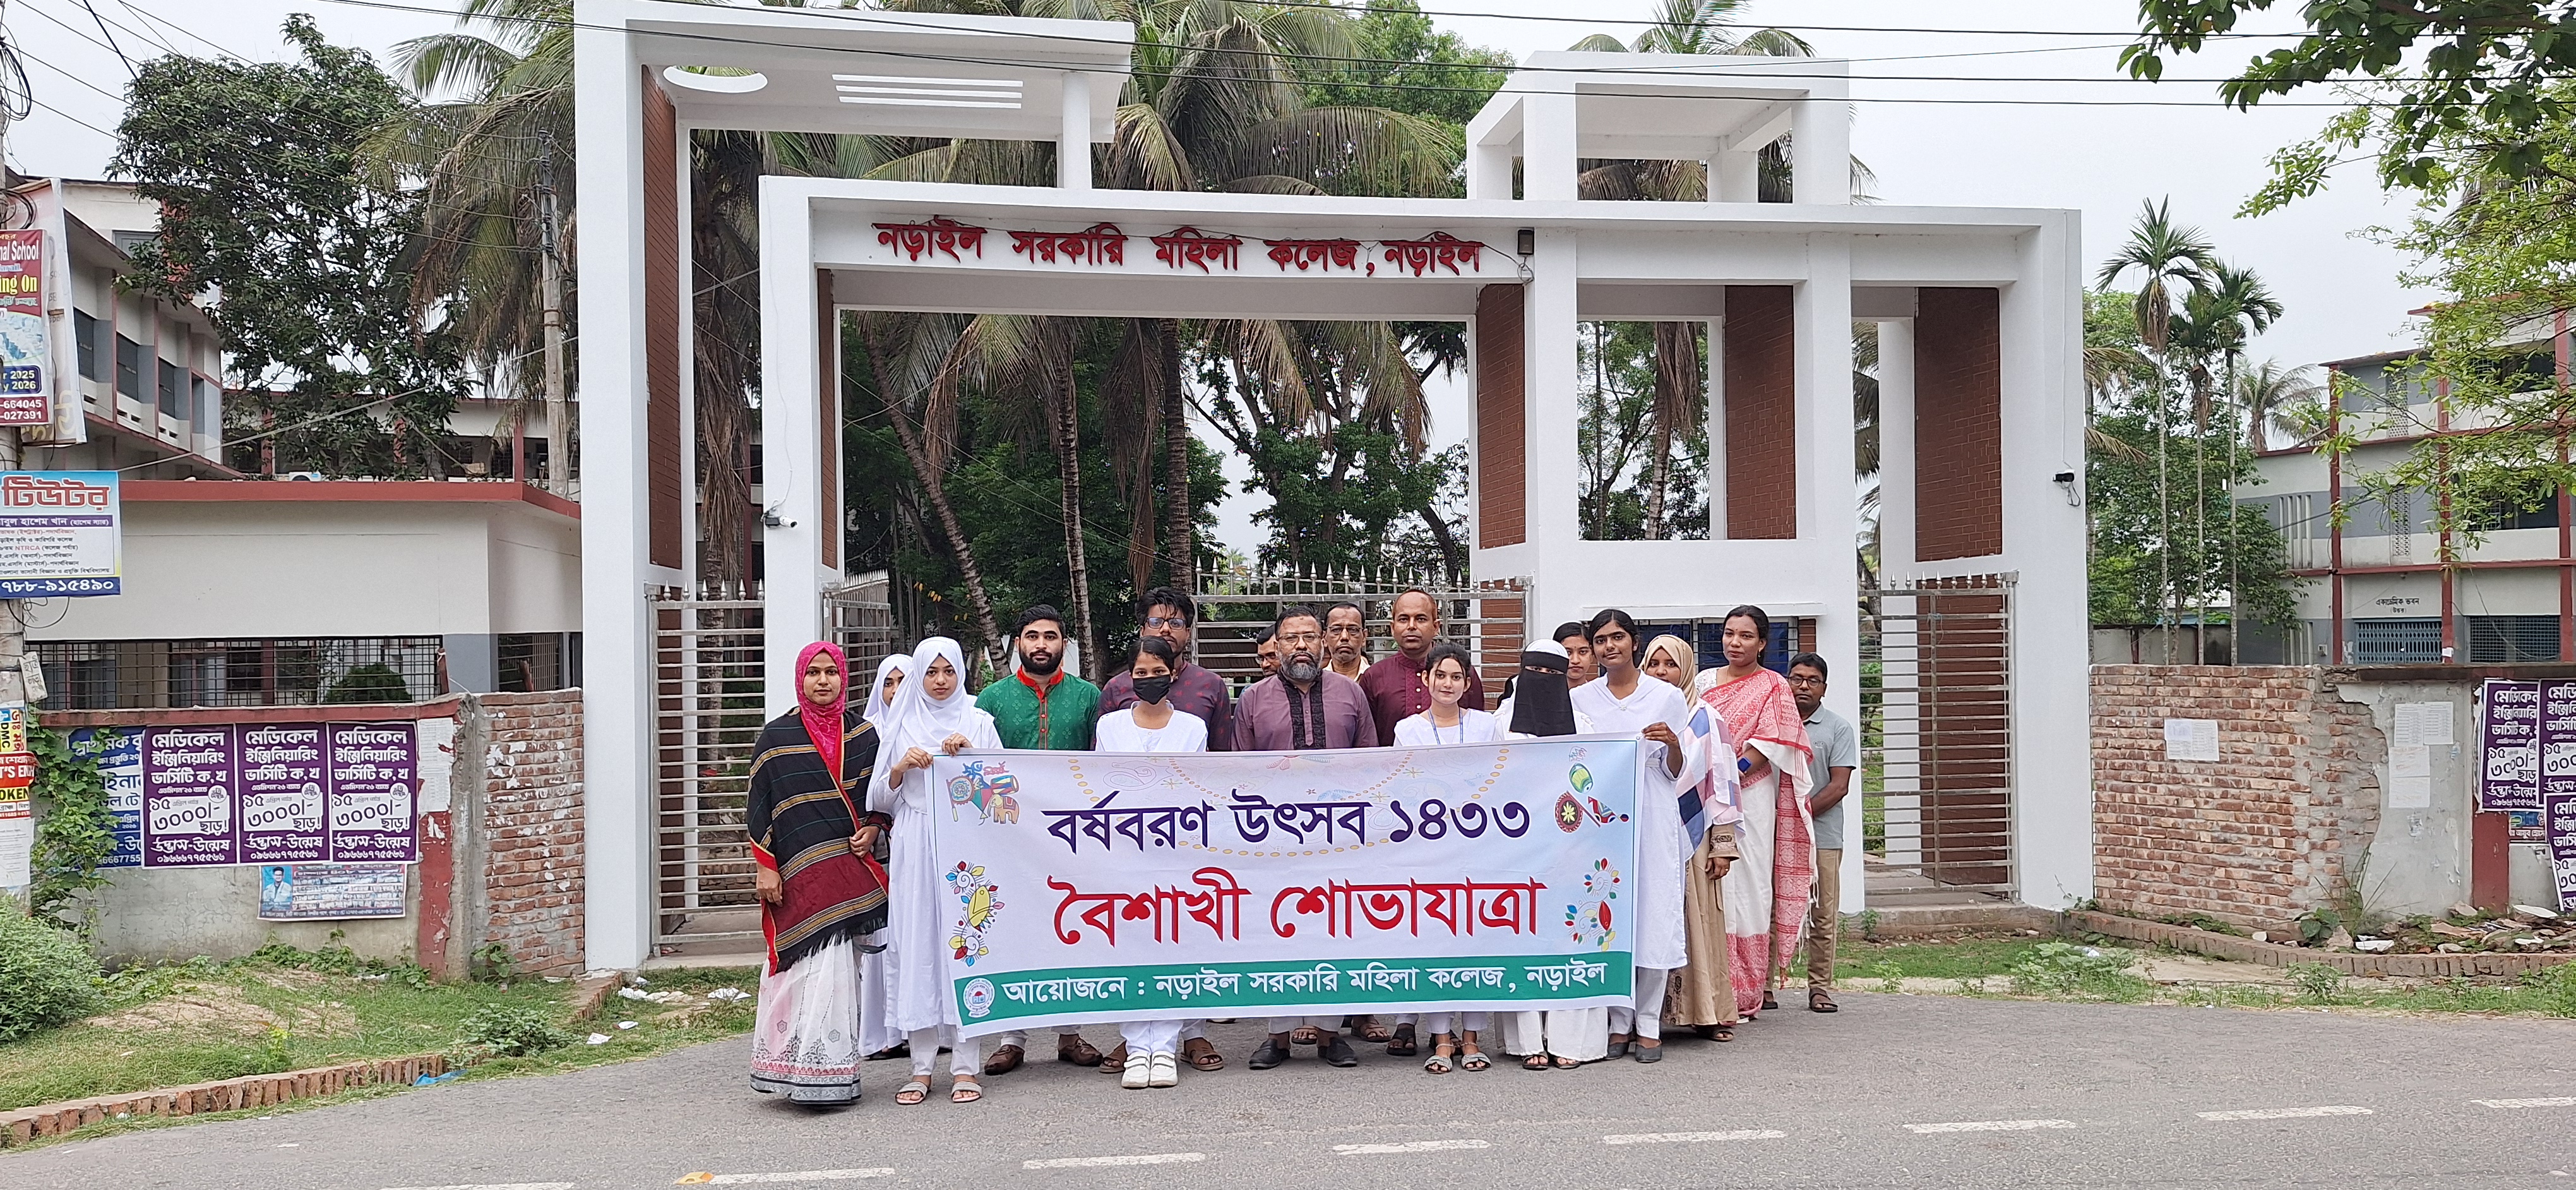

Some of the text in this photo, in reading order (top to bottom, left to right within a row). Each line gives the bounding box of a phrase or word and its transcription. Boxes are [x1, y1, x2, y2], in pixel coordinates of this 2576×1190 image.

[11, 239, 39, 260] School
[871, 215, 987, 263] নড়াইল
[1007, 222, 1129, 266] সরকারি
[1150, 226, 1244, 275] মহিলা
[1379, 231, 1485, 277] নড়াইল
[21, 274, 37, 292] On
[10, 370, 35, 379] 2025
[12, 381, 36, 390] 2026
[1, 476, 110, 511] টিউটর
[20, 517, 48, 526] হাশেম
[51, 517, 68, 526] খান
[1, 579, 114, 593] ৭৮৮-৯১৫৪৯০
[1, 723, 10, 748] DMC
[152, 729, 225, 747] মেডিকেল
[246, 726, 318, 744] মেডিকেল
[335, 726, 407, 744] মেডিকেল
[152, 748, 225, 766] ইঞ্জিনিয়ারিং
[245, 745, 318, 763] ইঞ্জিনিয়ারিং
[335, 746, 407, 763] ইঞ্জিনিয়ারিং
[2490, 748, 2505, 759] ১৫
[2546, 744, 2560, 754] ১৫
[151, 767, 194, 784] ভার্সিটি
[244, 764, 288, 781] ভার্সিটি
[334, 764, 377, 780] ভার্সিটি
[0, 788, 29, 800] OKEN
[245, 796, 264, 807] ১৫
[334, 795, 352, 807] ১৫
[152, 799, 170, 810] ১৫
[1040, 789, 1530, 854] বর্ষবরণ উৎসব ১৪৩৩
[157, 853, 225, 862] ০৯৬৬৬৭৭৫৫৬৬
[251, 850, 318, 859] ০৯৬৬৬৭৭৫৫৬৬
[338, 850, 404, 858] ০৯৬৬৬৭৭৫৫৬৬
[1047, 867, 1548, 947] বৈশাখী শোভাযাত্রা
[1001, 976, 1128, 1005] আয়োজনে
[1153, 967, 1242, 1002] নড়াইল
[1247, 963, 1340, 995] সরকারি
[1346, 961, 1420, 994] মহিলা
[1524, 958, 1608, 992] নড়াইল
